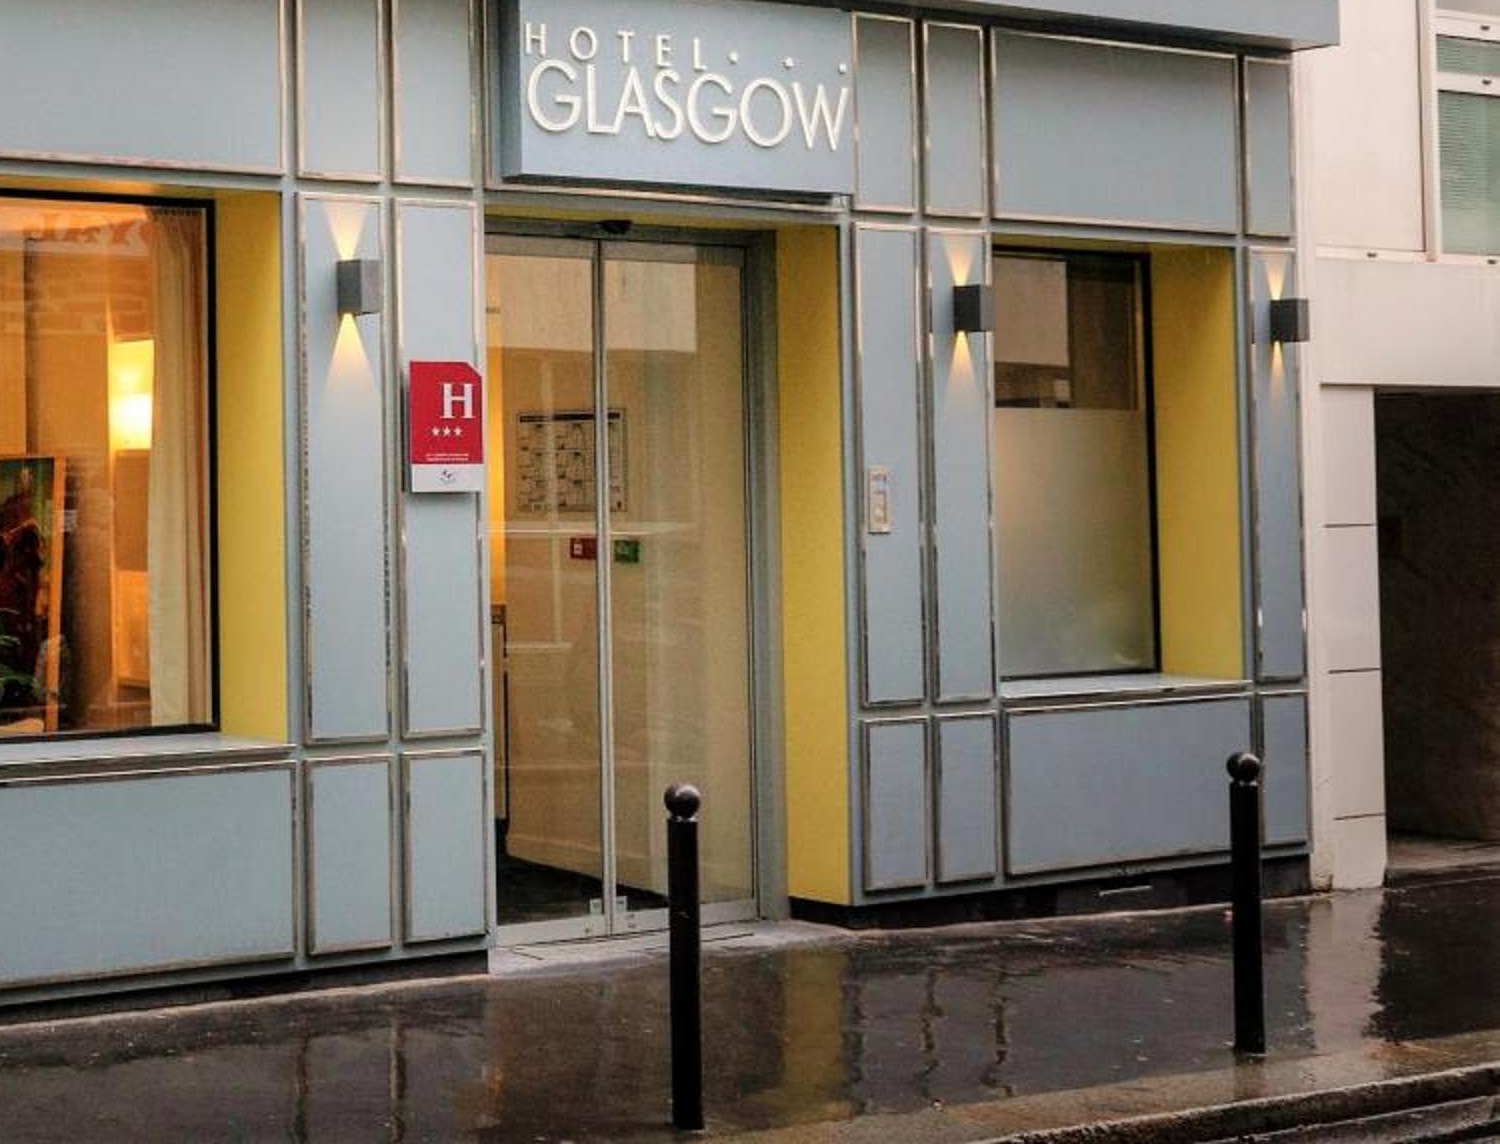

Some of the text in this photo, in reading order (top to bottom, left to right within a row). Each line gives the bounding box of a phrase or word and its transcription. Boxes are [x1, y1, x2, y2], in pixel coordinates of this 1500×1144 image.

[524, 22, 708, 72] HOTEL
[526, 58, 850, 152] GLASGOW
[440, 381, 476, 419] H
